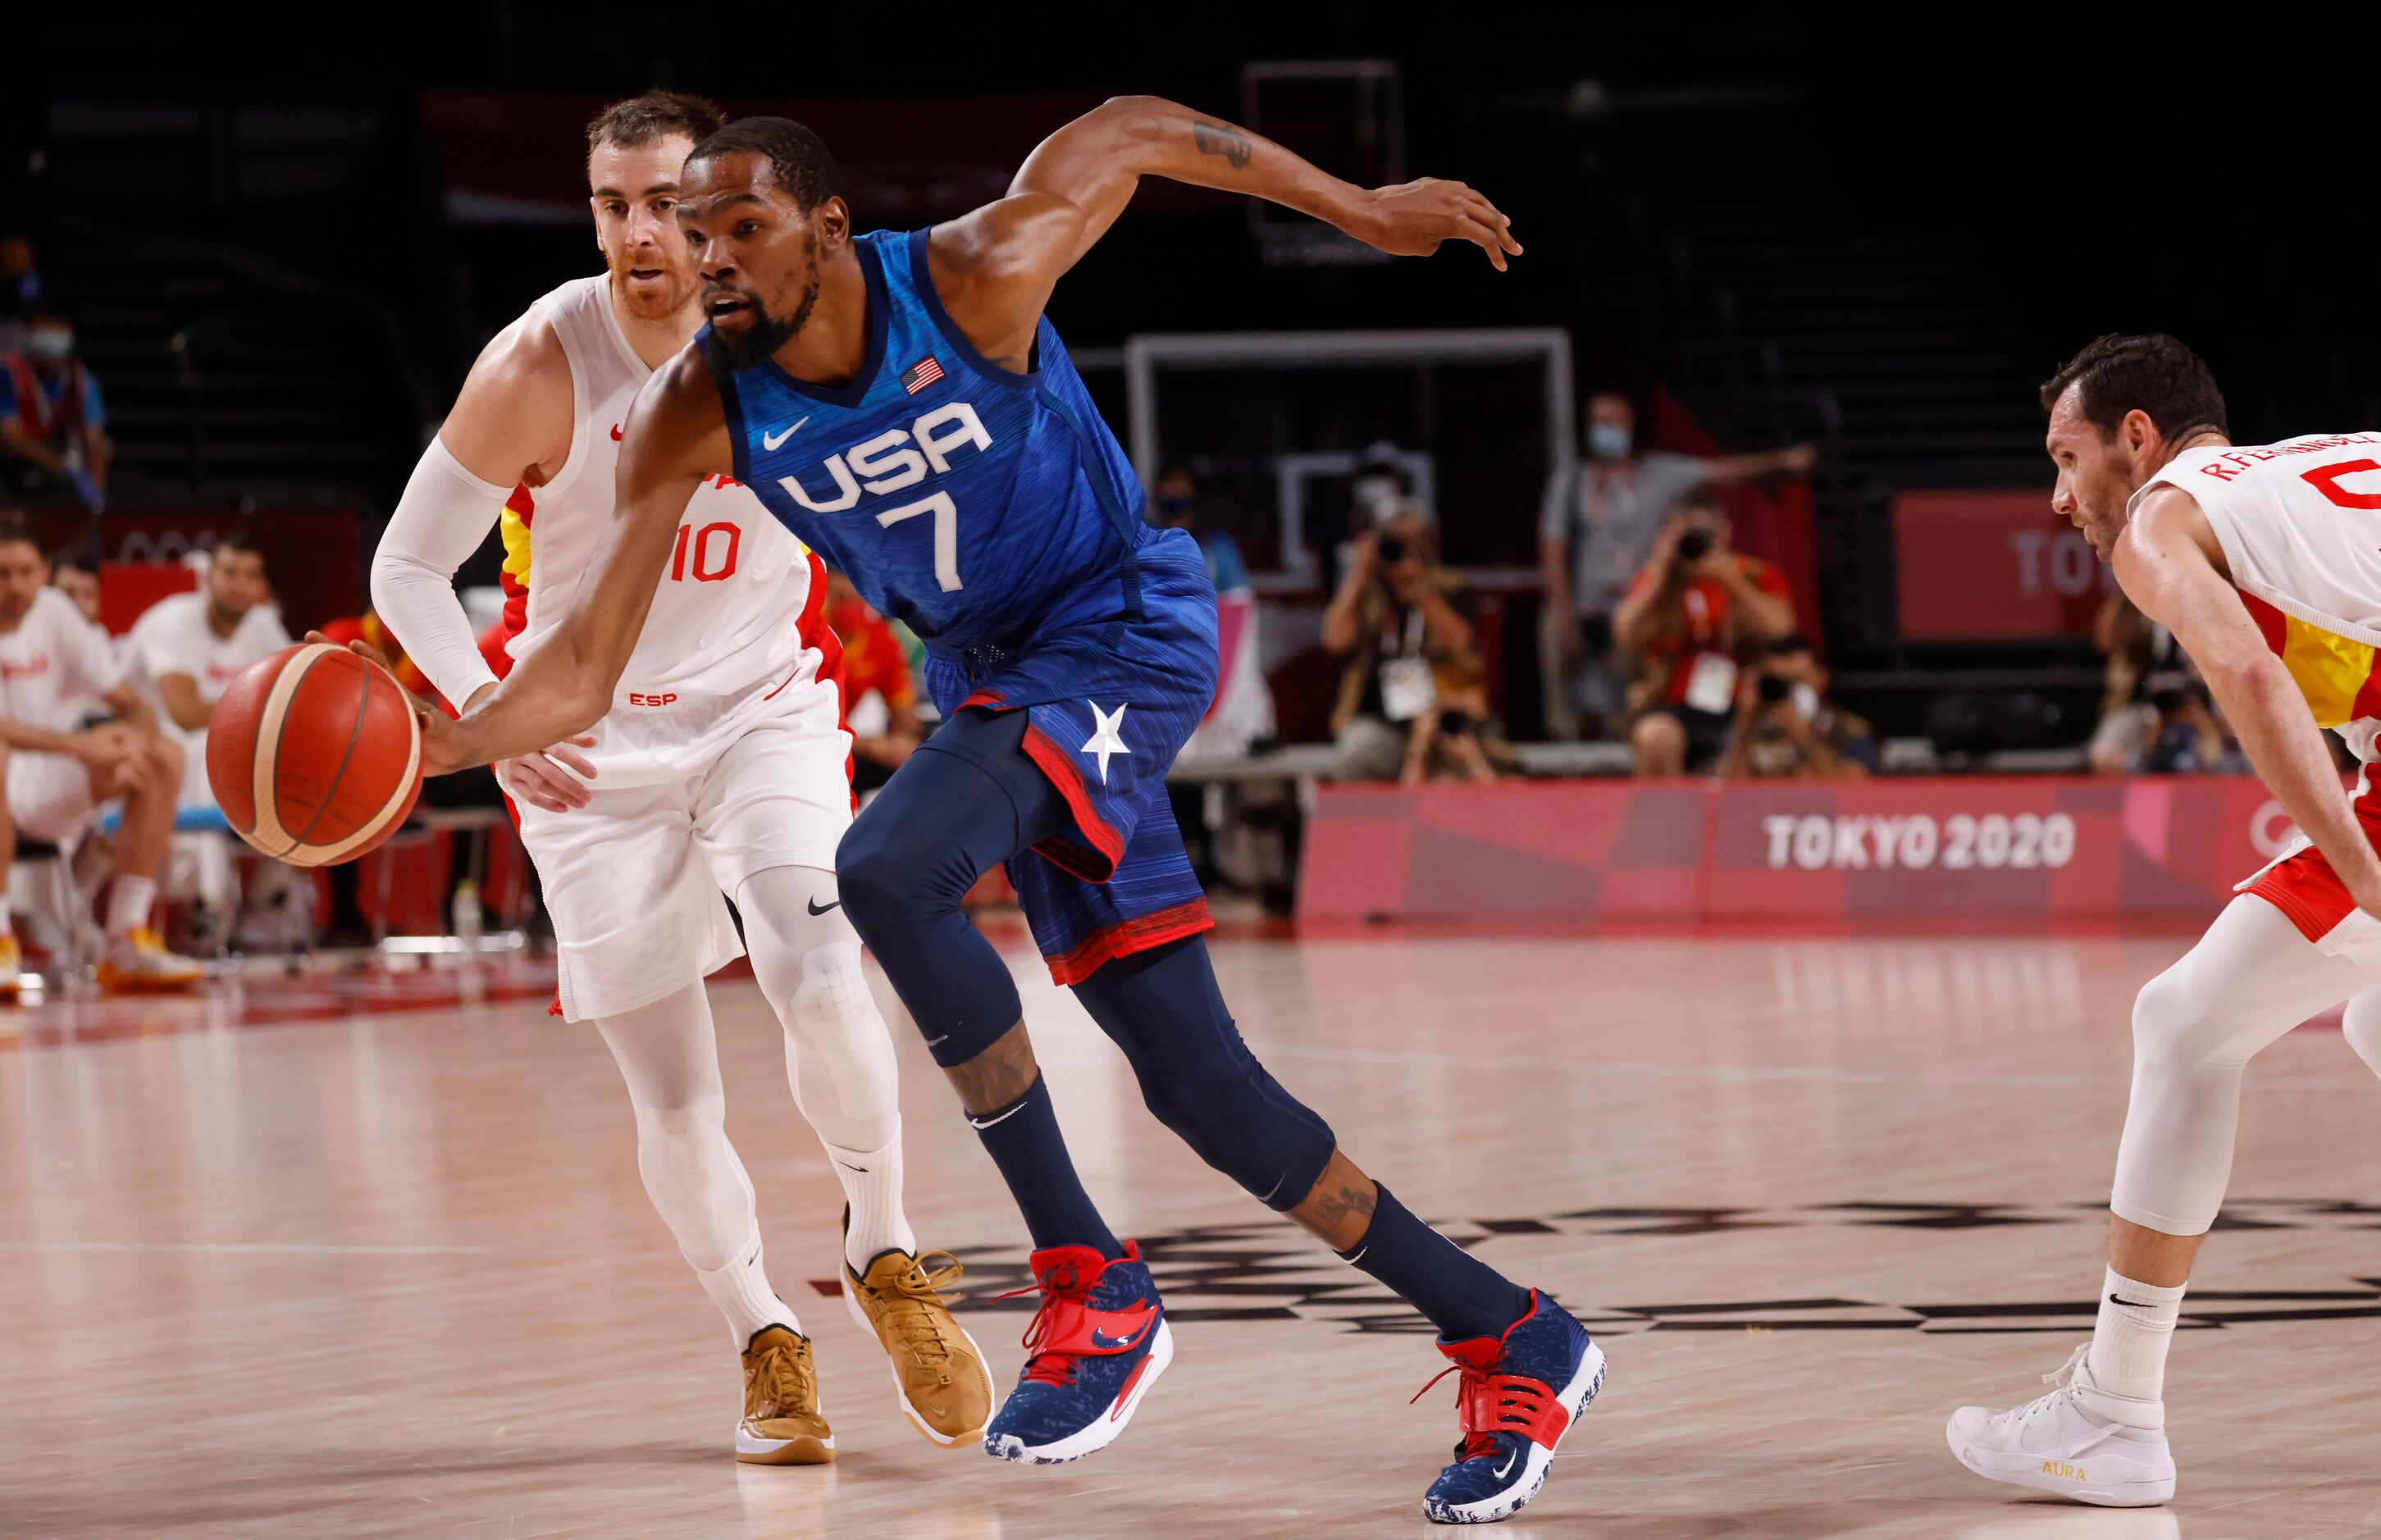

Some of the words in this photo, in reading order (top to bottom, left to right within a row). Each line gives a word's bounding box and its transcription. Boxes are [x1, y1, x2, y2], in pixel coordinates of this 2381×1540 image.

[777, 402, 993, 513] USA
[671, 522, 741, 582] 10
[875, 490, 963, 593] 7
[629, 692, 677, 707] ESP
[1763, 813, 1938, 870] TOKYO
[1941, 812, 2077, 870] 2020
[2041, 1460, 2087, 1482] AURA
